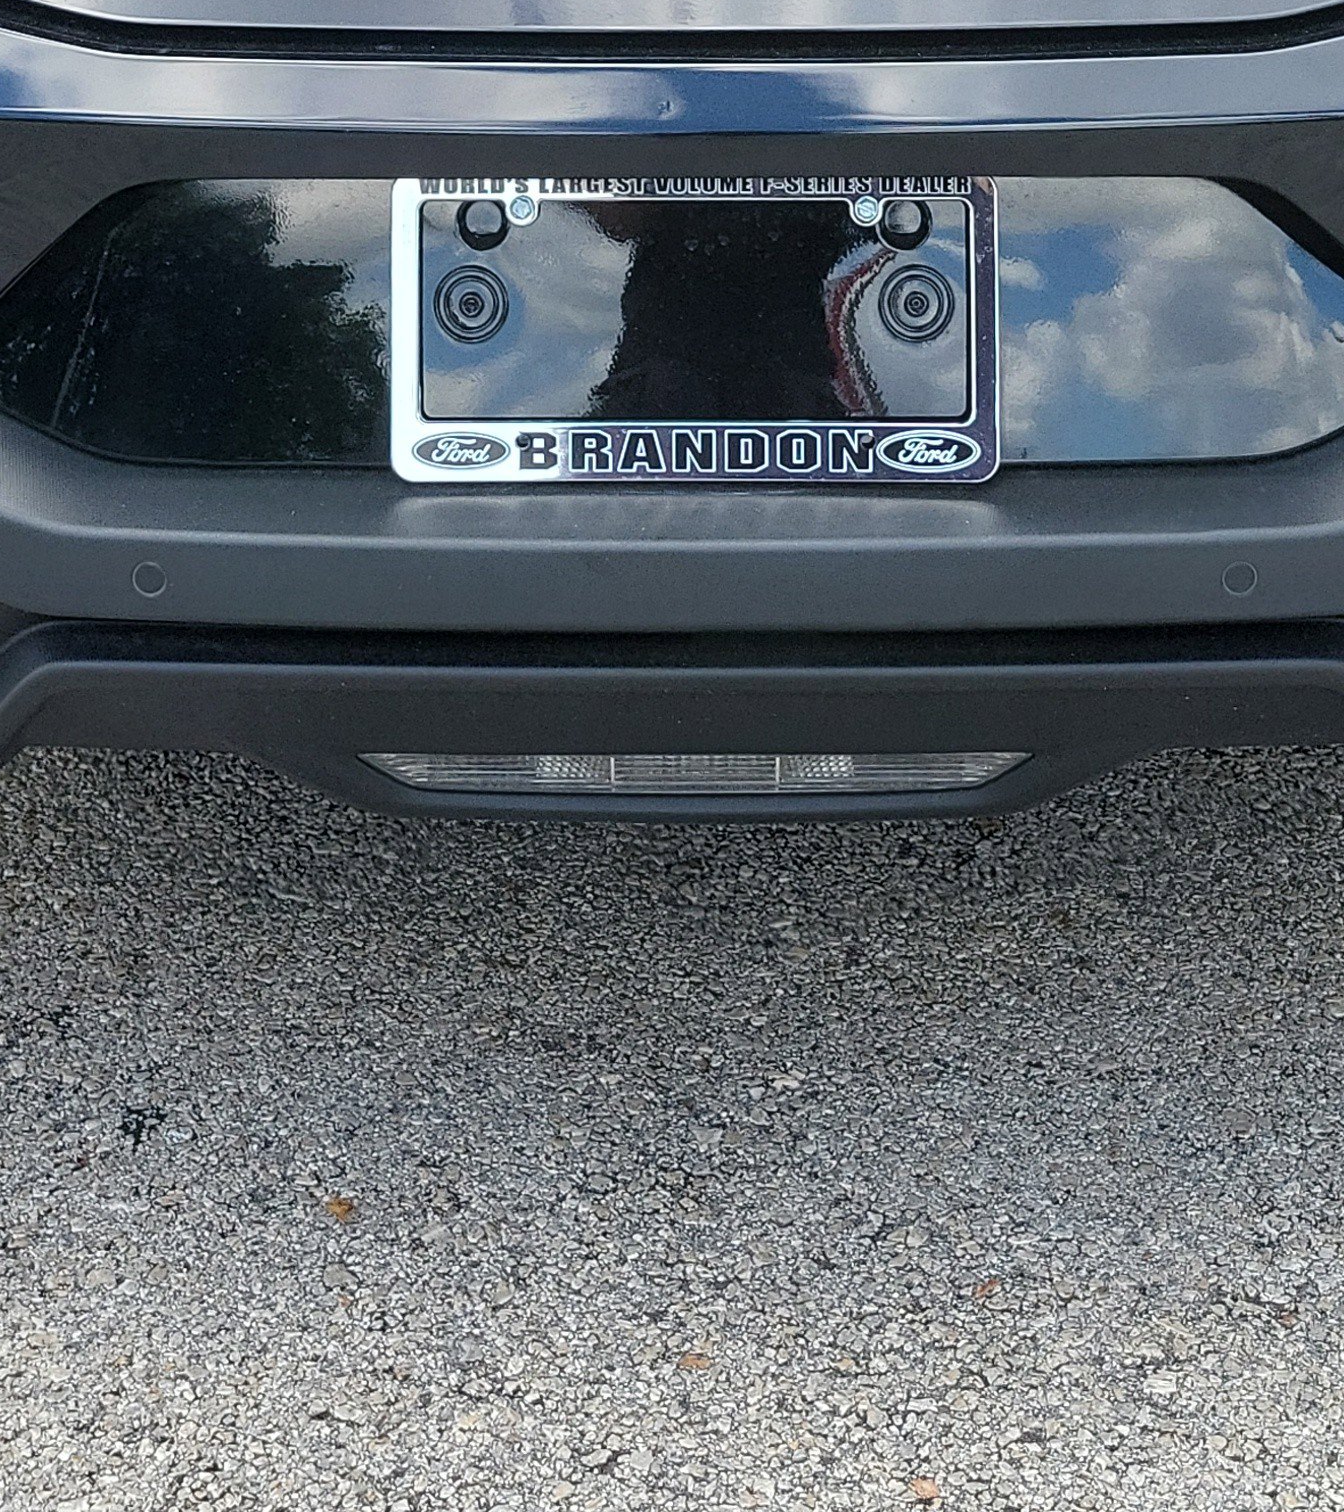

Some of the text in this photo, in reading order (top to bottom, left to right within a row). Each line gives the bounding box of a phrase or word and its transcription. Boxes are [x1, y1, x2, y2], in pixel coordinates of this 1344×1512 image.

[419, 176, 972, 195] WORLD'S LARGEST VOLUME F-SERIES DEALER
[431, 429, 959, 473] Ford BRANDON Ford
